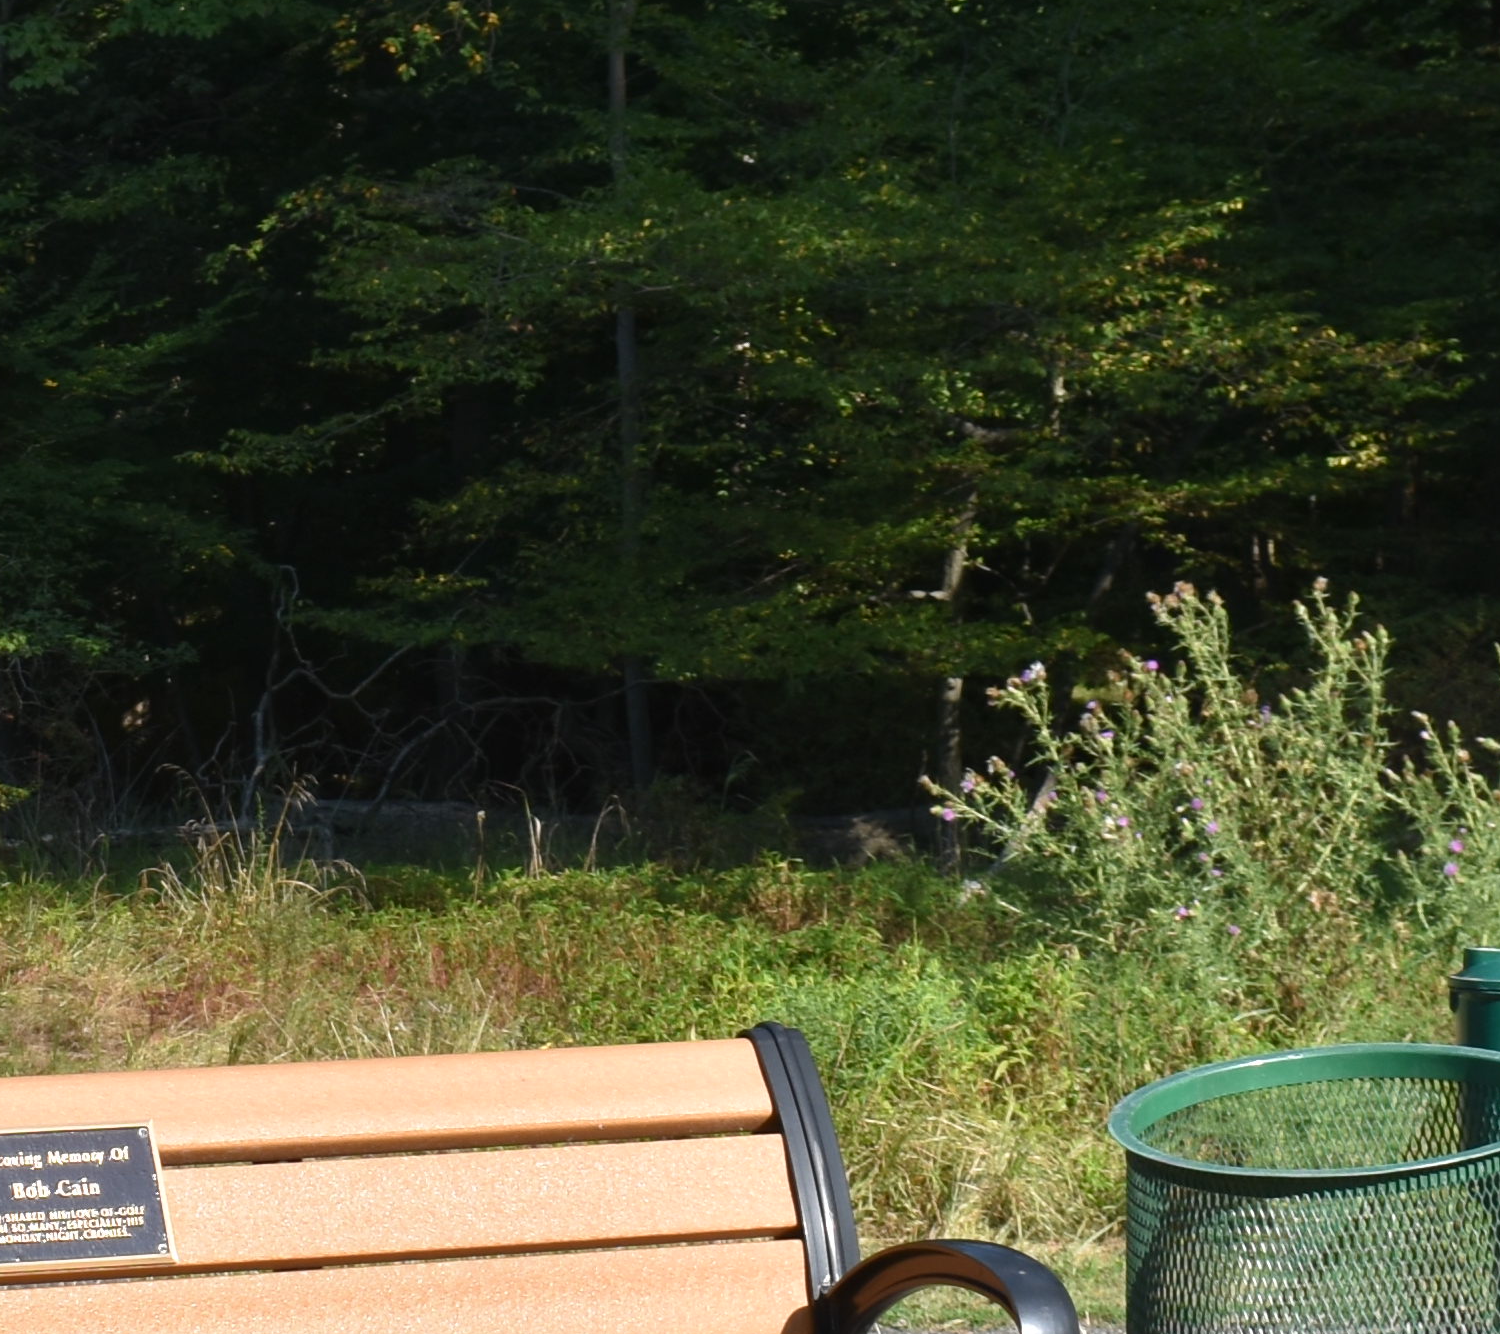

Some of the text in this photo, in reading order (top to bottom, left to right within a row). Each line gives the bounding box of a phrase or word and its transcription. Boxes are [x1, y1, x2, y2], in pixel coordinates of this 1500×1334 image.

[46, 1150, 105, 1167] Memory
[109, 1145, 130, 1162] Of
[10, 1177, 101, 1201] Bob Cain
[3, 1211, 46, 1223] SHARED
[71, 1208, 100, 1220] LOVE
[115, 1204, 146, 1217] GOLF
[11, 1223, 26, 1234] SO
[66, 1216, 122, 1231] ESPECIALLY
[43, 1229, 79, 1242] NIGHT
